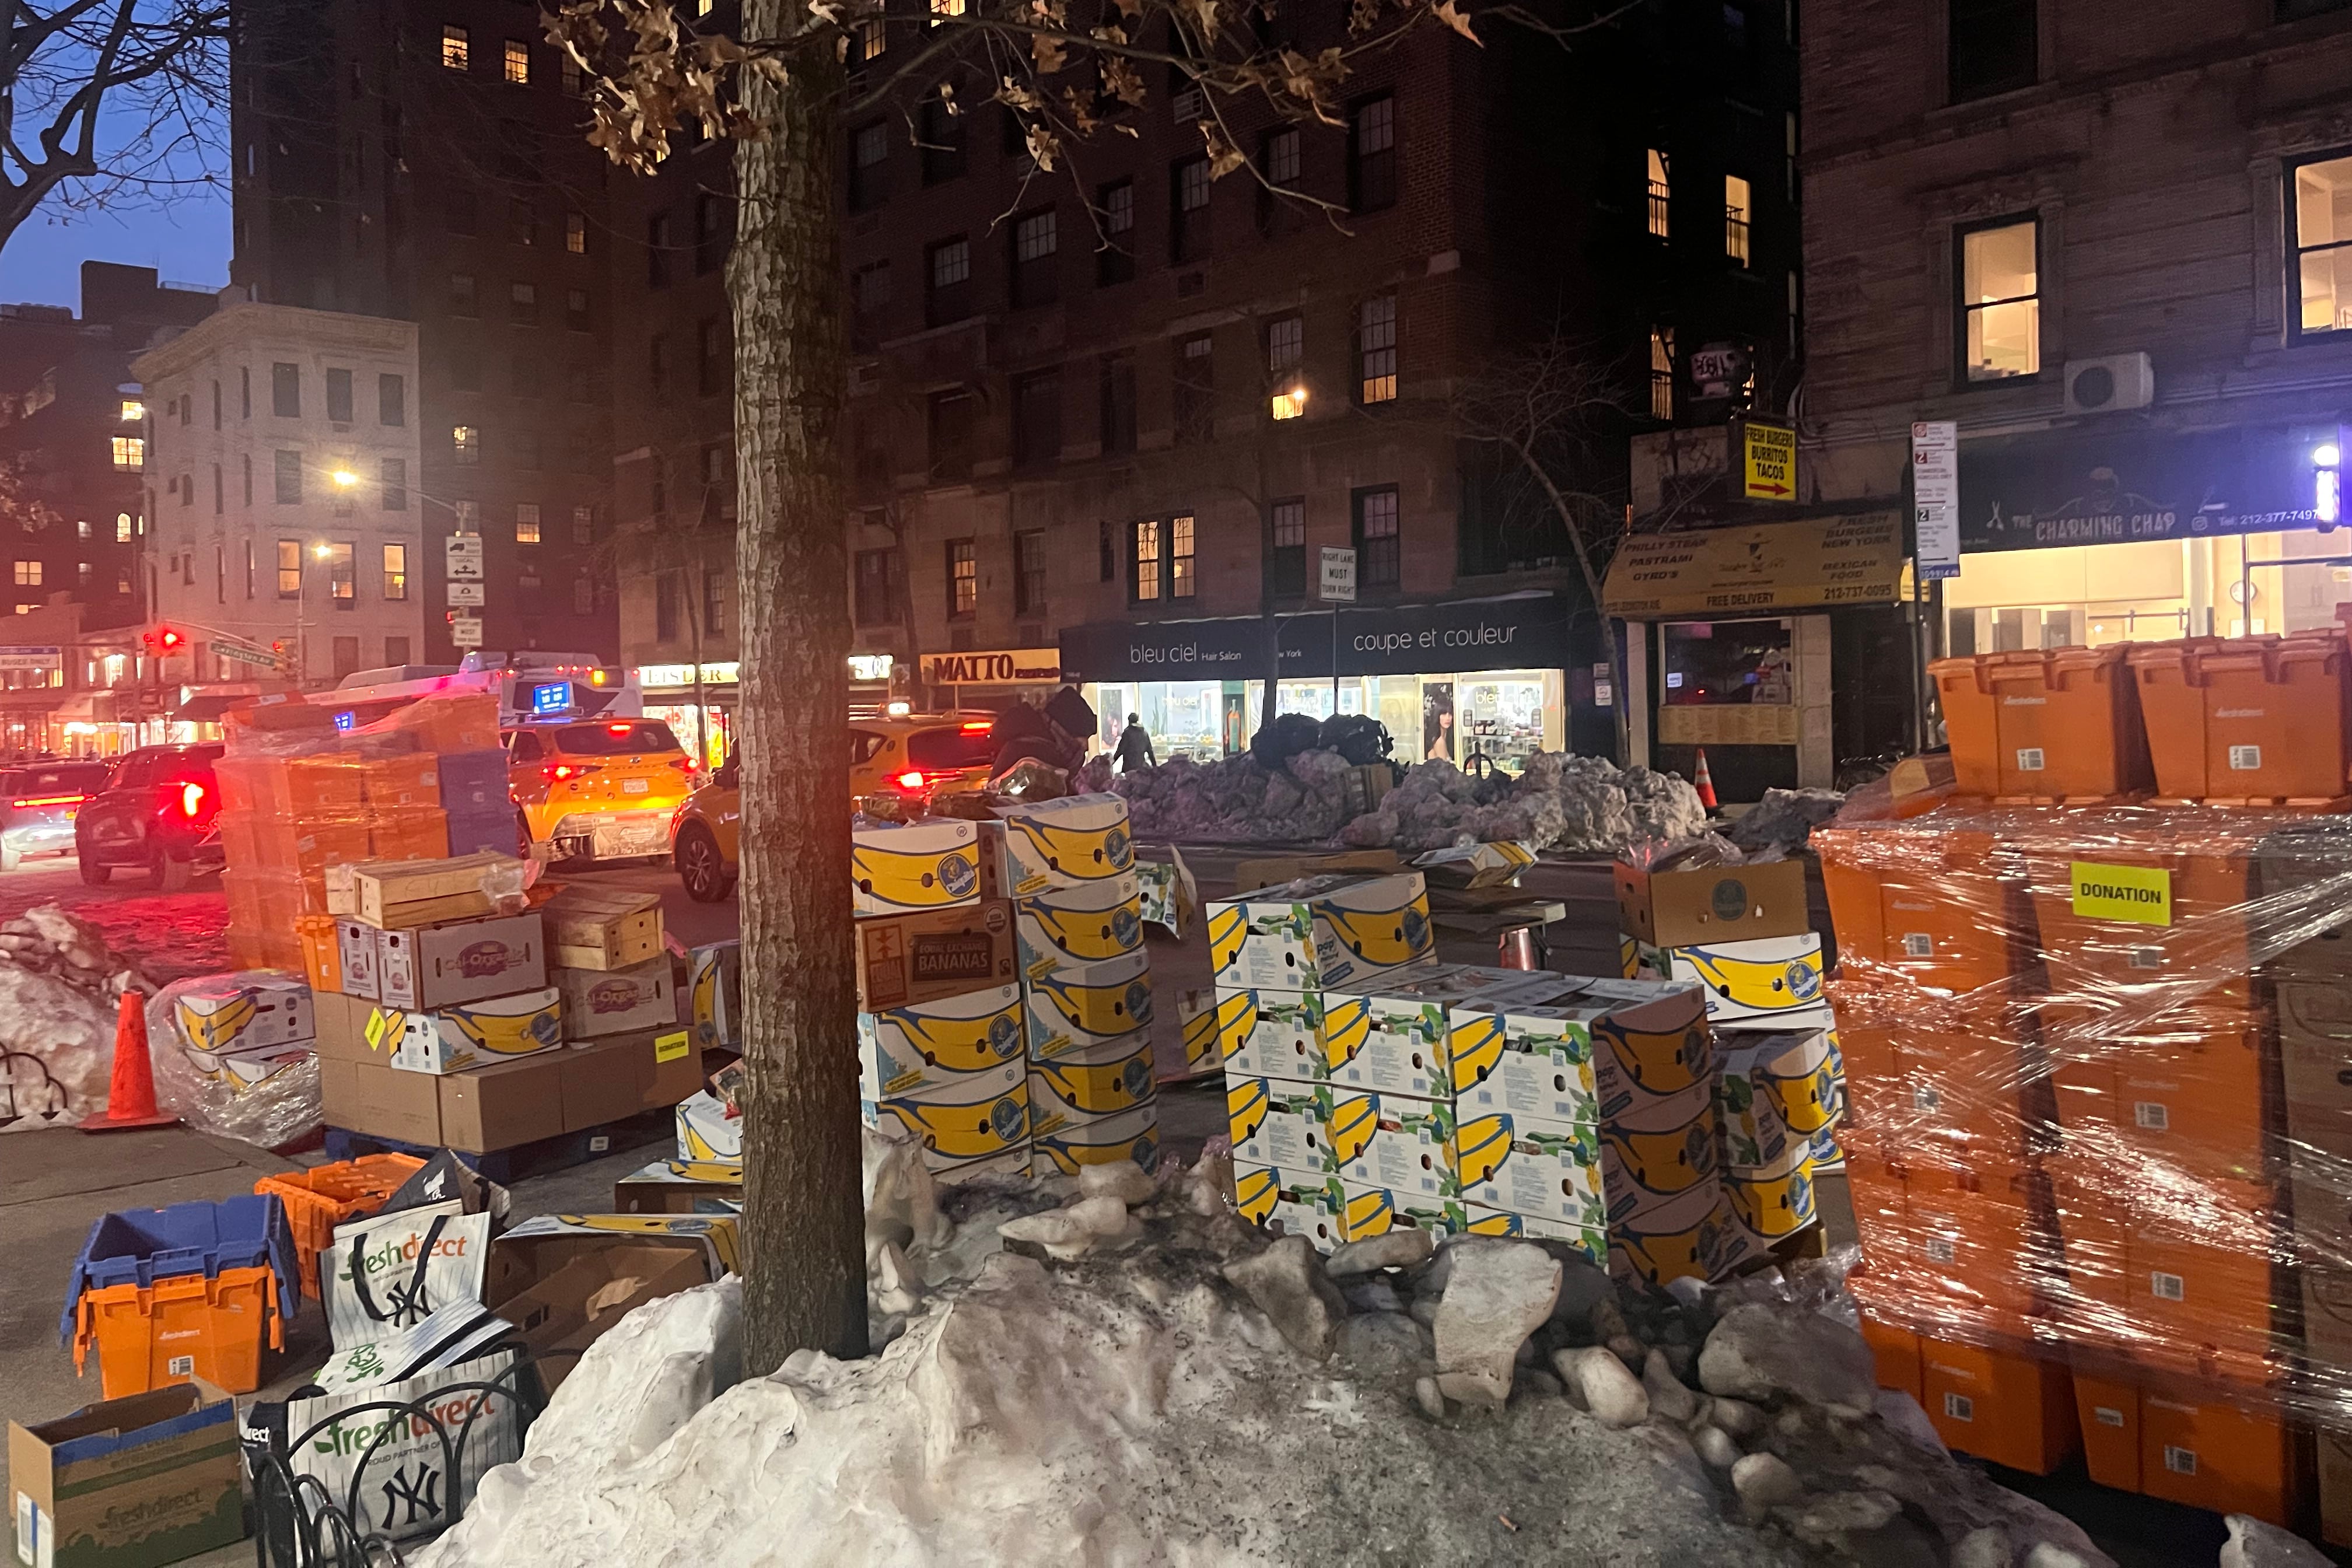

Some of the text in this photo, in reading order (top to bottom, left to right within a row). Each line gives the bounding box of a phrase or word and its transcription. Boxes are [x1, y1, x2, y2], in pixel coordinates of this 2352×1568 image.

[1746, 426, 1794, 448] FRESH BURGERS
[1752, 446, 1788, 464] BURRITOS
[1756, 463, 1785, 480] TACOS
[2239, 509, 2318, 525] 212-377-7497
[2035, 512, 2176, 541] CHARMING CHAP
[1625, 541, 1663, 552] PHILLY
[1821, 535, 1891, 549] NEW YORK
[1322, 552, 1339, 562] RIGHT
[1629, 555, 1693, 566] PASTRAMI
[1822, 559, 1877, 570] MEXICAN
[1329, 568, 1347, 579] MUST
[1633, 570, 1679, 581] GYRO'S
[1830, 570, 1864, 580] FOOD
[1707, 592, 1774, 607] FREE DELIVERY
[1353, 622, 1517, 656] coupe et couleur
[1130, 644, 1165, 663] bleu
[1170, 642, 1196, 663] ciel
[1202, 652, 1217, 661] Hair
[1219, 651, 1241, 660] Salon
[1284, 648, 1301, 658] York
[933, 653, 1014, 681] MATTO
[2081, 883, 2161, 904] DONATION
[919, 942, 988, 954] EQUAL EXCHANGE
[918, 952, 988, 971] BANANAS
[314, 1394, 495, 1457] freshdirect
[394, 1444, 429, 1461] PARTNER
